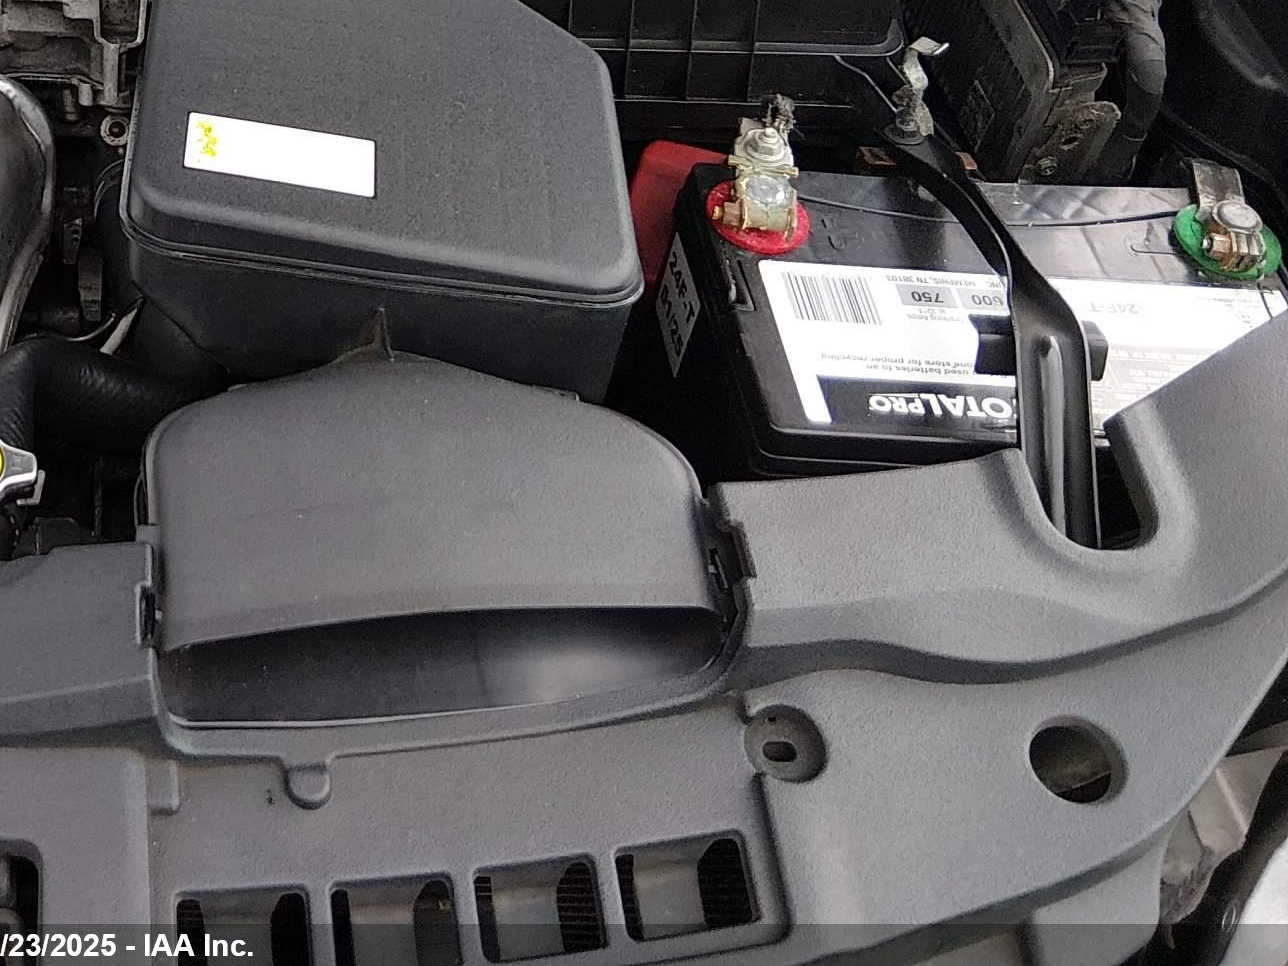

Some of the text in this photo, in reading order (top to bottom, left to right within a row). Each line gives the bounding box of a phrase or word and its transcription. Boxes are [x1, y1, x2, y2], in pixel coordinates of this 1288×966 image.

[911, 290, 944, 304] 750
[971, 294, 1004, 307] 600
[1088, 301, 1139, 315] 24F-T
[907, 358, 921, 367] for
[924, 360, 951, 368] store
[894, 365, 942, 376] batteries
[868, 392, 1017, 419] OTALPRO
